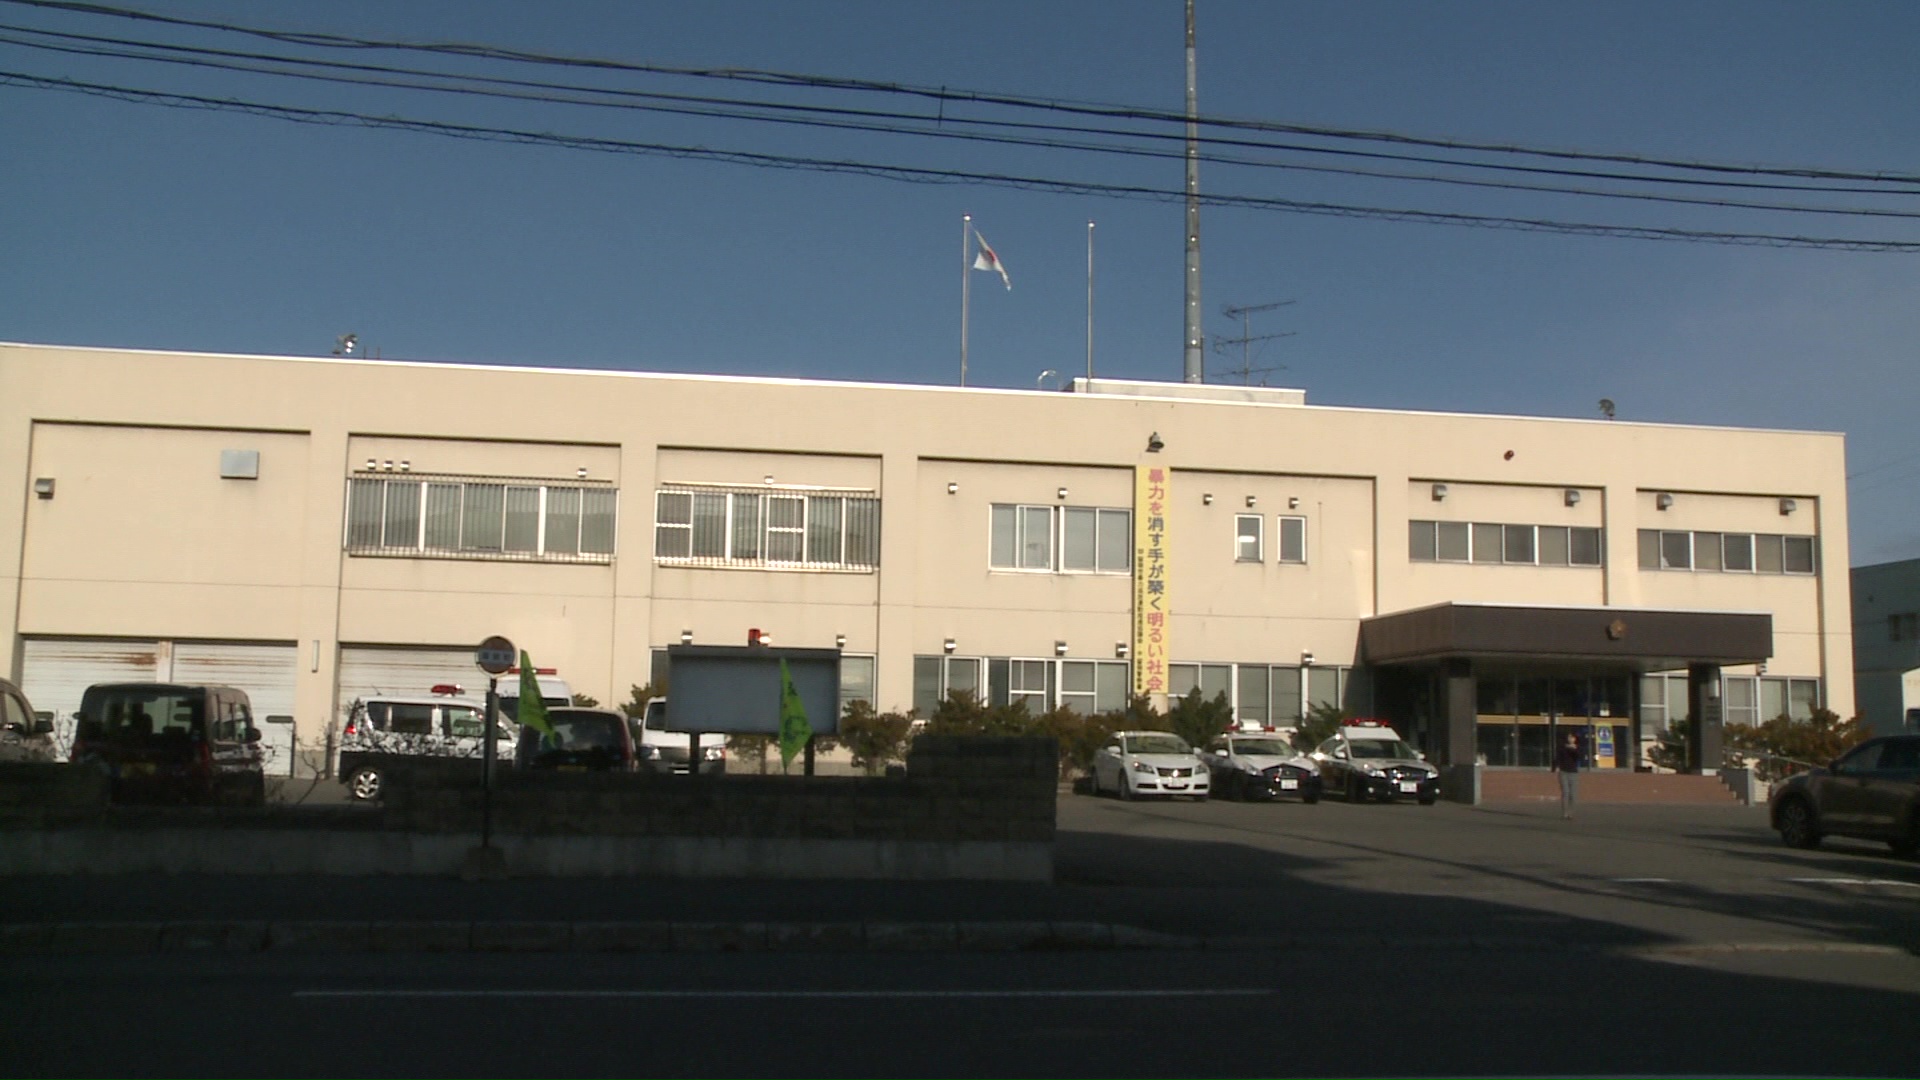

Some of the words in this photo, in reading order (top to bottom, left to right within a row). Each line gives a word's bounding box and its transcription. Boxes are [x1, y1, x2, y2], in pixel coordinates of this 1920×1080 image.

[1146, 469, 1165, 691] 暴力を消す手が築く明るい社会
